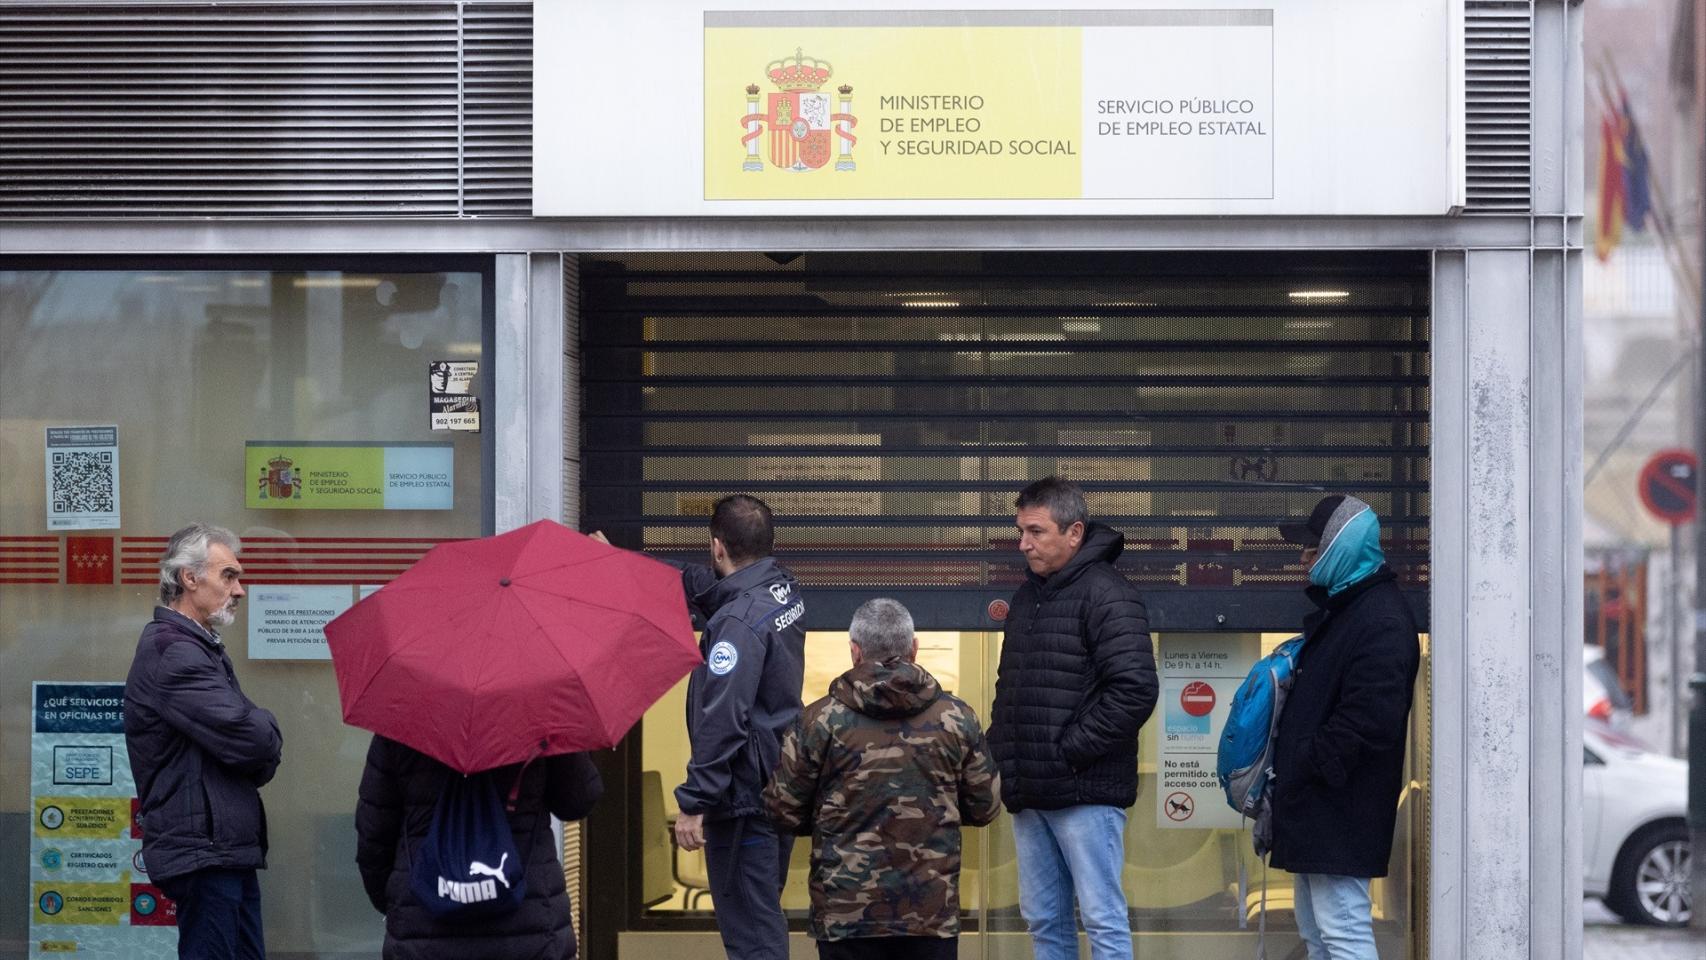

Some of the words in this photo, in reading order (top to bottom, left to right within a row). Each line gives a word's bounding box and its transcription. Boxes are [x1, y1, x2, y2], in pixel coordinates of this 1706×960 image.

[880, 95, 984, 110] MINISTERIO
[1098, 99, 1174, 114] SERVICIO
[1180, 96, 1254, 114] PÚBLICO
[880, 118, 904, 133] DE
[911, 118, 981, 133] EMPLEO
[1098, 121, 1121, 136] DE
[1127, 121, 1193, 136] EMPLEO
[1199, 121, 1267, 136] ESTATAL
[880, 140, 892, 155] Y
[897, 140, 1003, 155] SEGURIDAD
[1009, 140, 1077, 155] SOCIAL
[419, 472, 447, 480] PÚBLICO
[296, 609, 335, 617] PRESTACIONES
[43, 696, 68, 708] ¿QUÉ
[70, 698, 119, 707] SERVICIOS
[45, 711, 57, 719] EN
[59, 711, 103, 719] OFICINAS
[1165, 760, 1177, 768] No
[1180, 760, 1200, 768] está
[65, 767, 100, 779] SEPE
[1165, 770, 1208, 779] permitido
[438, 876, 497, 904] PUMA
